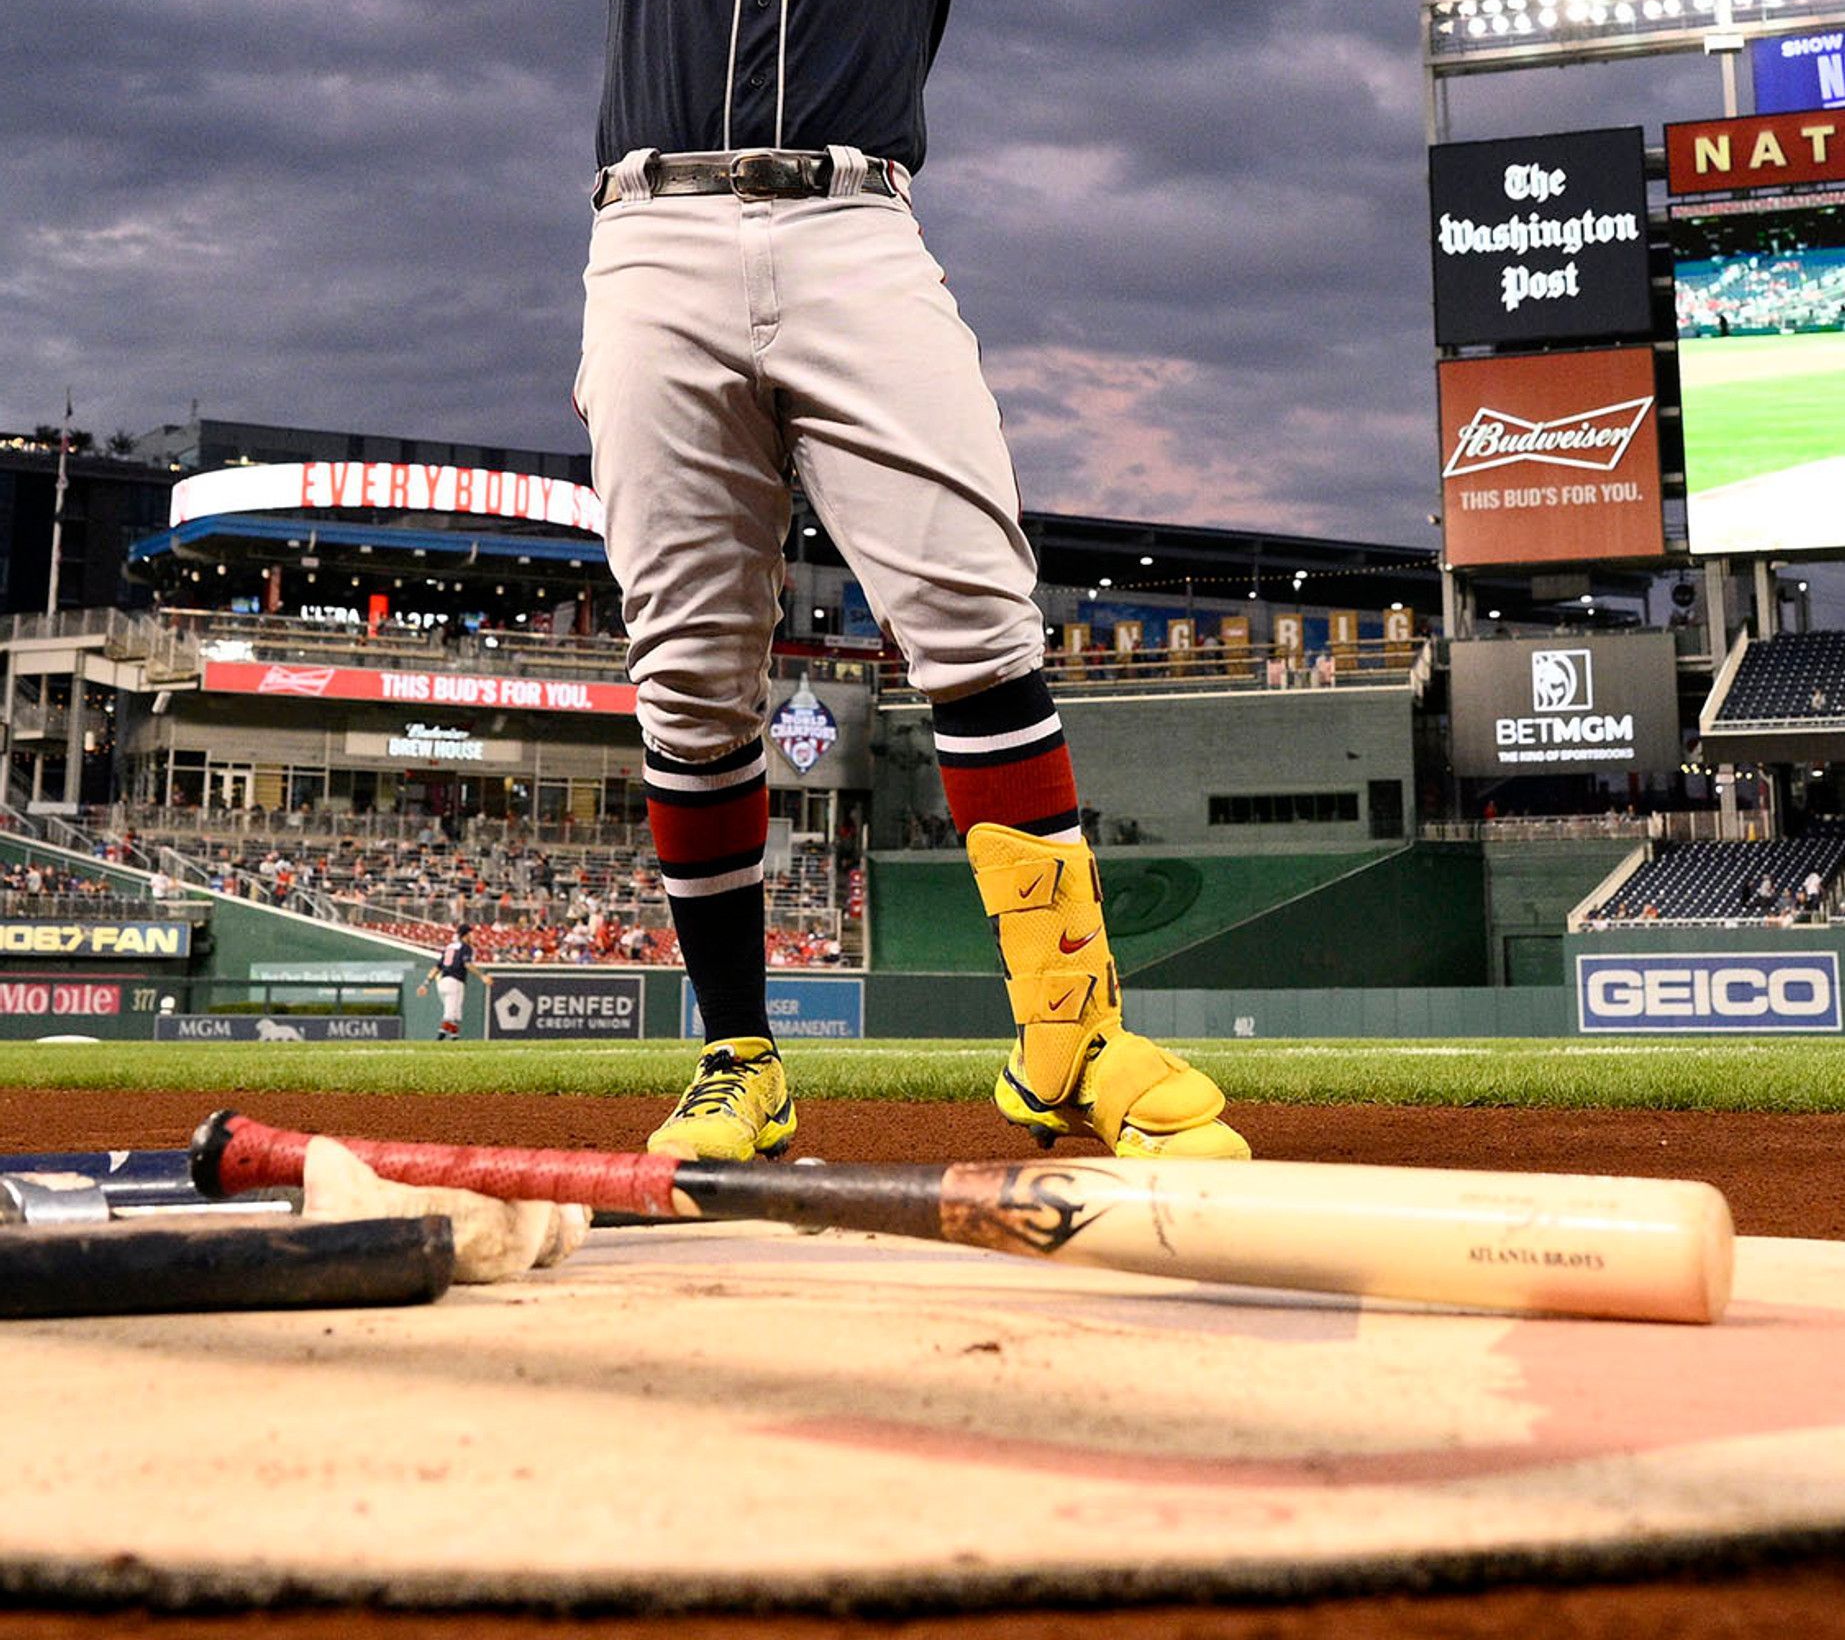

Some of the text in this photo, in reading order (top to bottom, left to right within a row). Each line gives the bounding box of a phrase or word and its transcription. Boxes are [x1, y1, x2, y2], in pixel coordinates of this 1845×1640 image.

[1781, 33, 1844, 57] SHOW
[1504, 163, 1566, 202] The
[1438, 209, 1640, 255] Washington
[1501, 261, 1580, 312] Post
[1458, 421, 1633, 458] Budweiser
[301, 463, 553, 522] EVERYBODY
[1460, 481, 1643, 510] THIS BUD'S FOR YOU.
[381, 674, 593, 709] THIS BUD'S FOR YOU.
[1496, 714, 1633, 745] BETMGM
[389, 737, 485, 760] BREW HOUSE
[92, 926, 178, 953] FAN
[537, 995, 633, 1016] PENFED
[1587, 967, 1831, 1017] GEICO
[178, 1019, 231, 1037] MGM
[327, 1020, 378, 1037] MGM
[536, 1017, 631, 1029] CREDIT UNION
[1469, 1246, 1605, 1270] ATLANTA BRAVES
